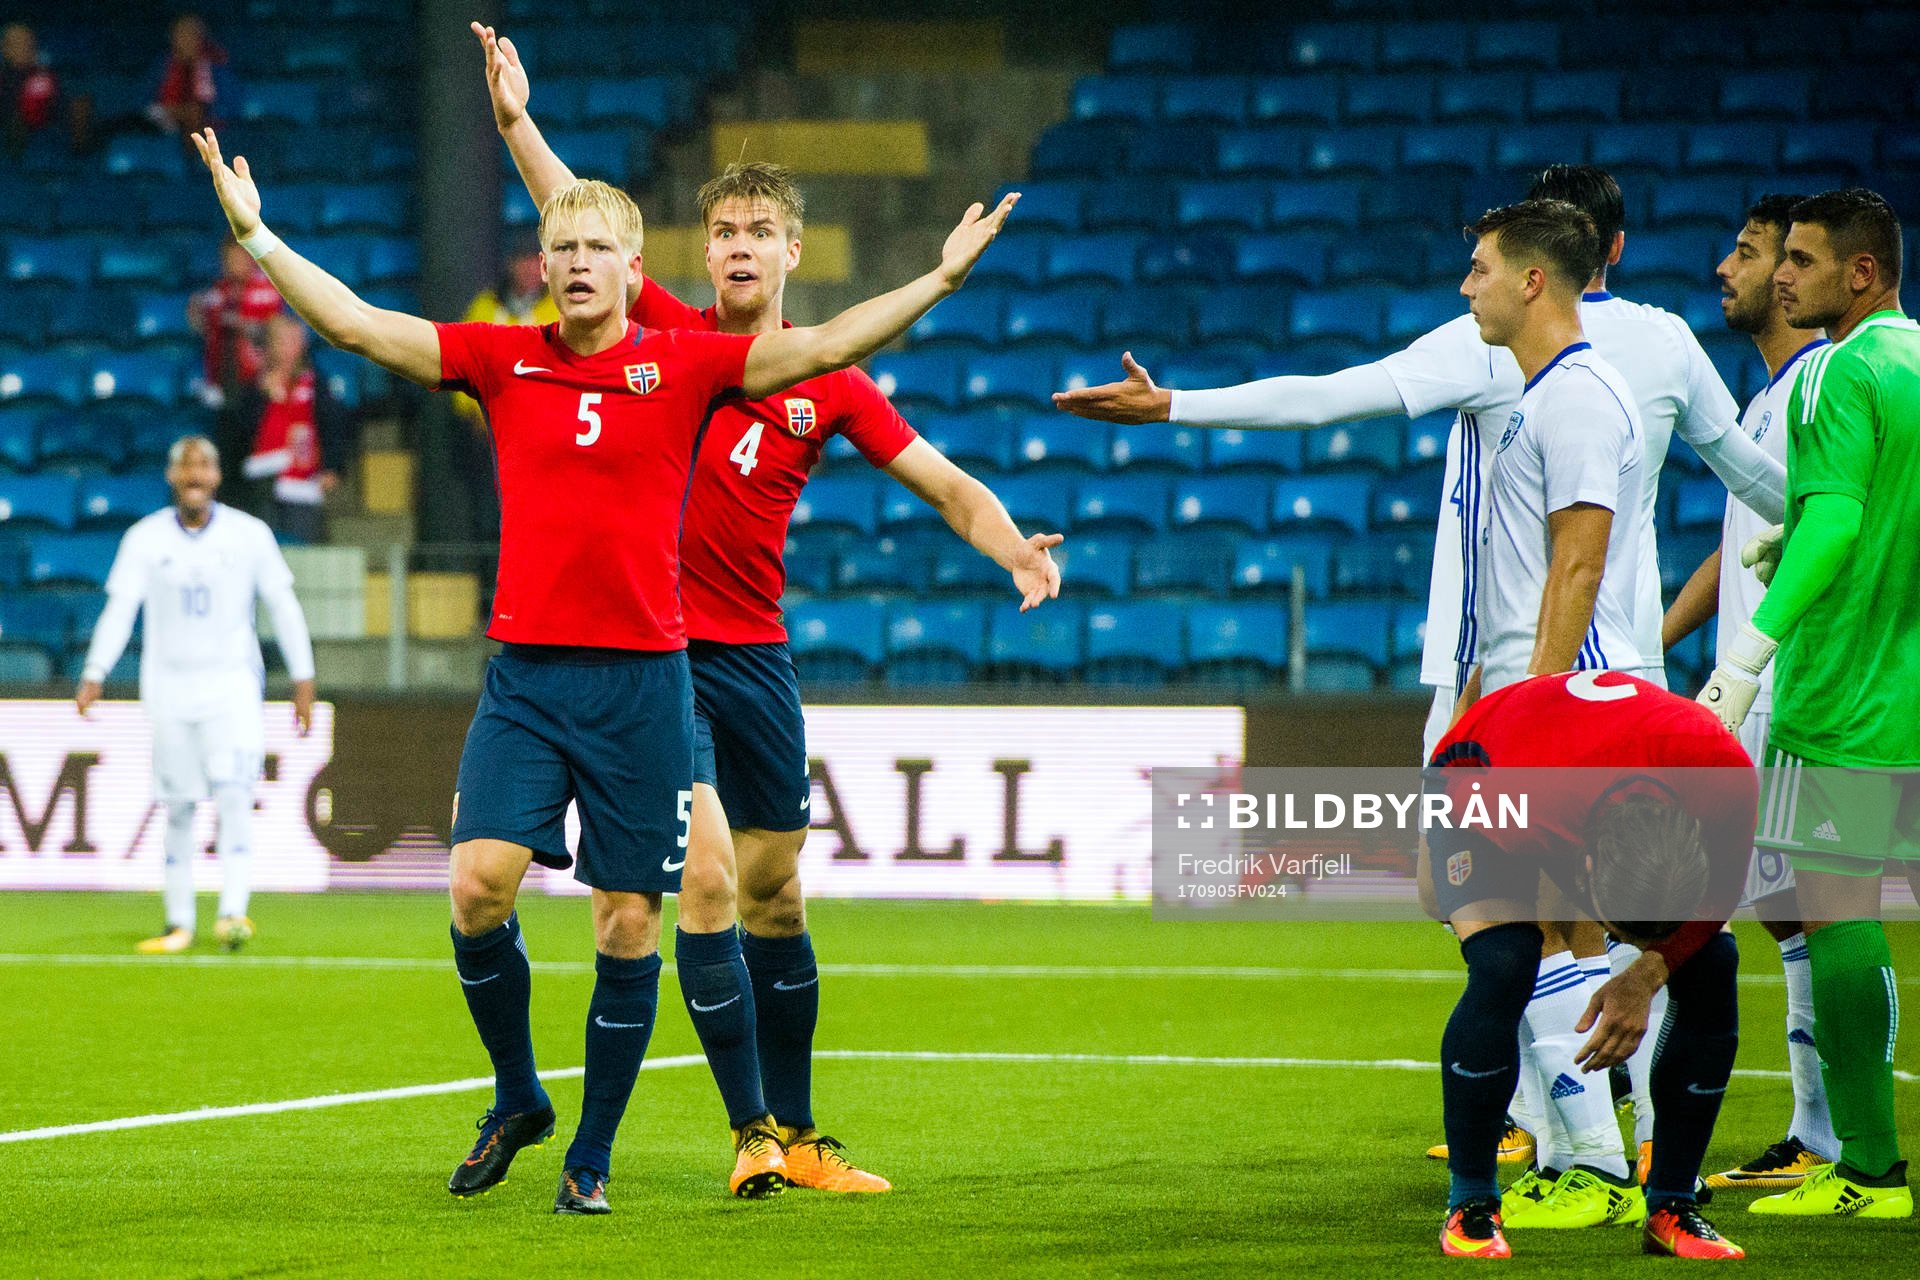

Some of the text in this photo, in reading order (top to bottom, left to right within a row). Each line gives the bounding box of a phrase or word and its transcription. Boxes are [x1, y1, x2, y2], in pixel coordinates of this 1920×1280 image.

[576, 392, 603, 446] 5
[729, 421, 765, 477] 4
[181, 585, 210, 617] 10
[1550, 1084, 1585, 1100] adidas
